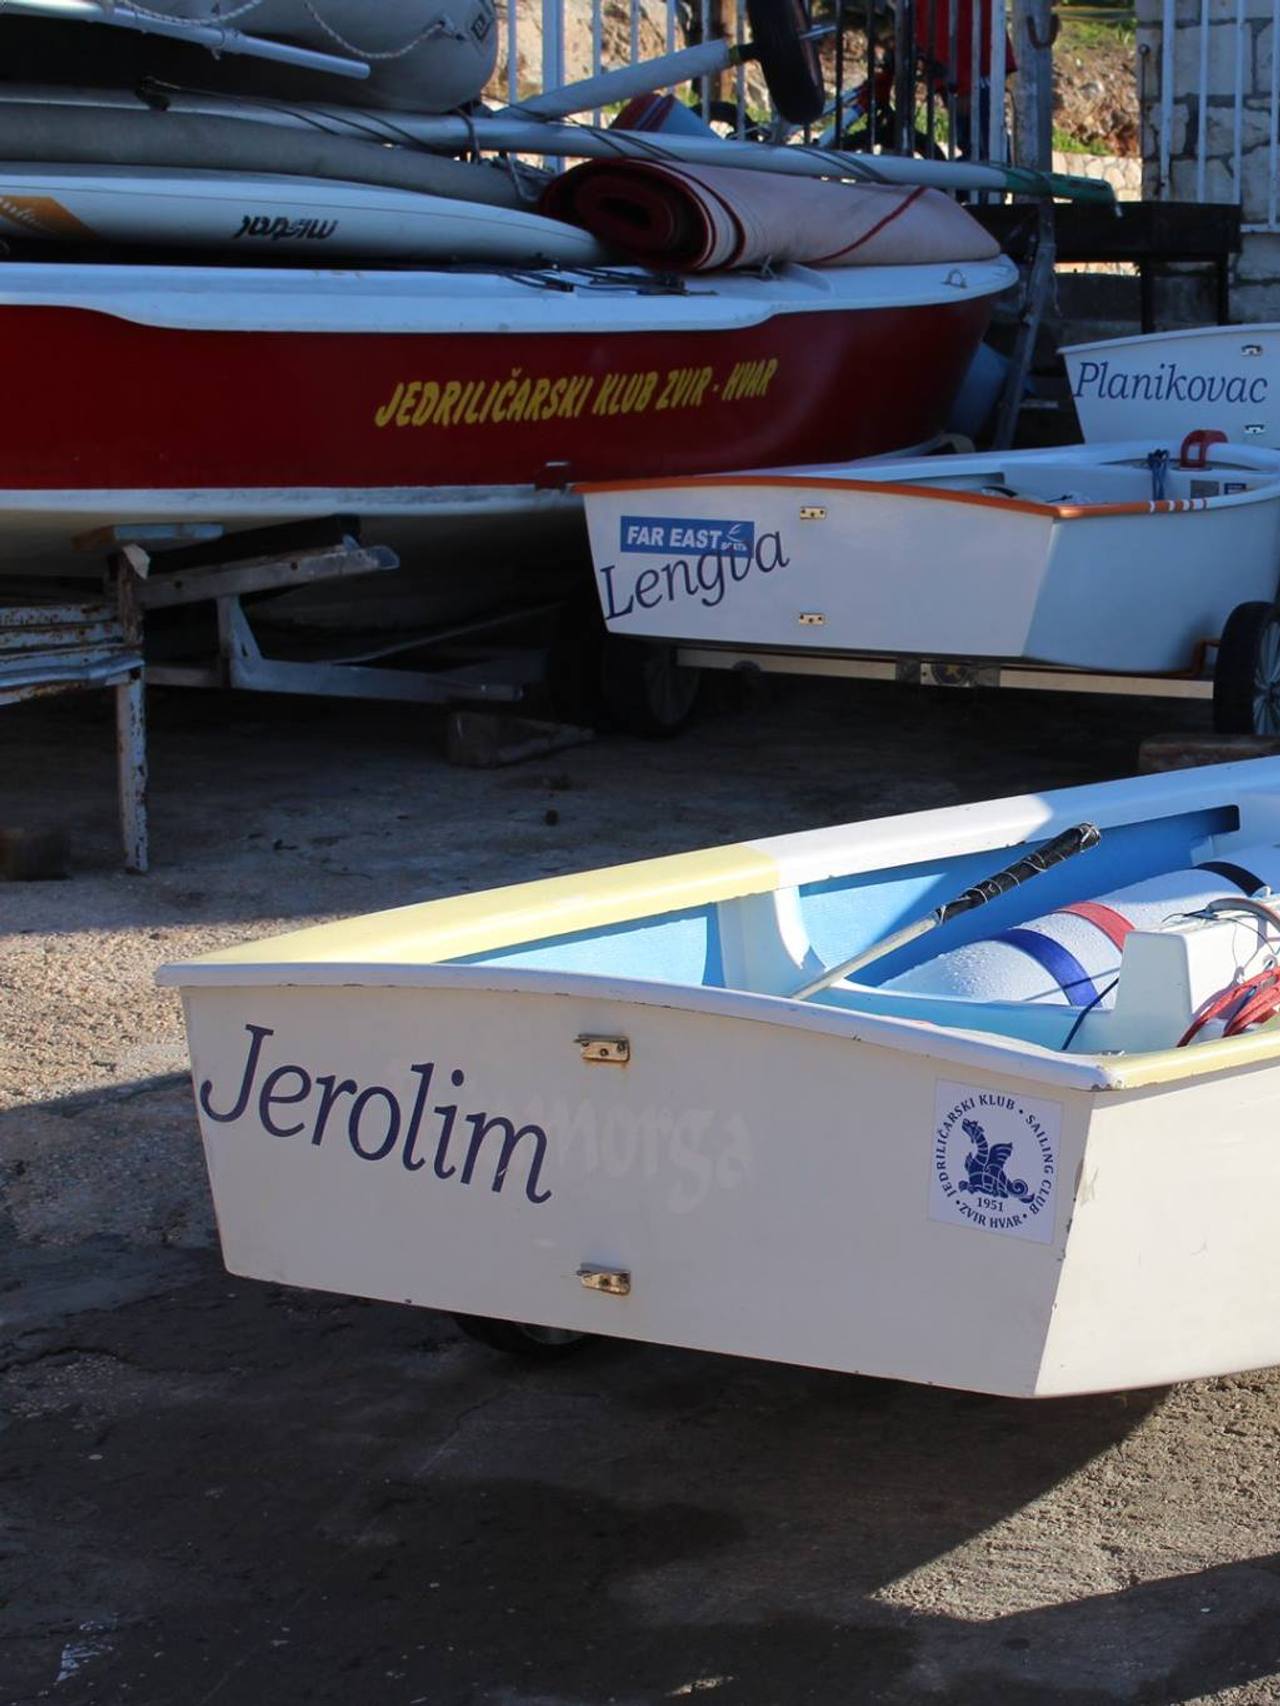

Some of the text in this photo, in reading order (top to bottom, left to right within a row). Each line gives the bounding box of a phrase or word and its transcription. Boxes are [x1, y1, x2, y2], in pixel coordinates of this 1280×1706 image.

[374, 367, 595, 428] JEDRILIČARSKI
[592, 371, 659, 416] KLUB
[722, 357, 779, 401] HVAR
[1073, 360, 1269, 404] Planikovac
[626, 525, 724, 550] FAR EAST
[600, 530, 791, 621] Lengva
[201, 1023, 553, 1205] Jerolim
[978, 1093, 1016, 1111] KLUB
[1025, 1114, 1054, 1216] SAILING CLUB
[958, 1202, 1023, 1229] ZVIR HVAR
[977, 1196, 1004, 1213] 1951
